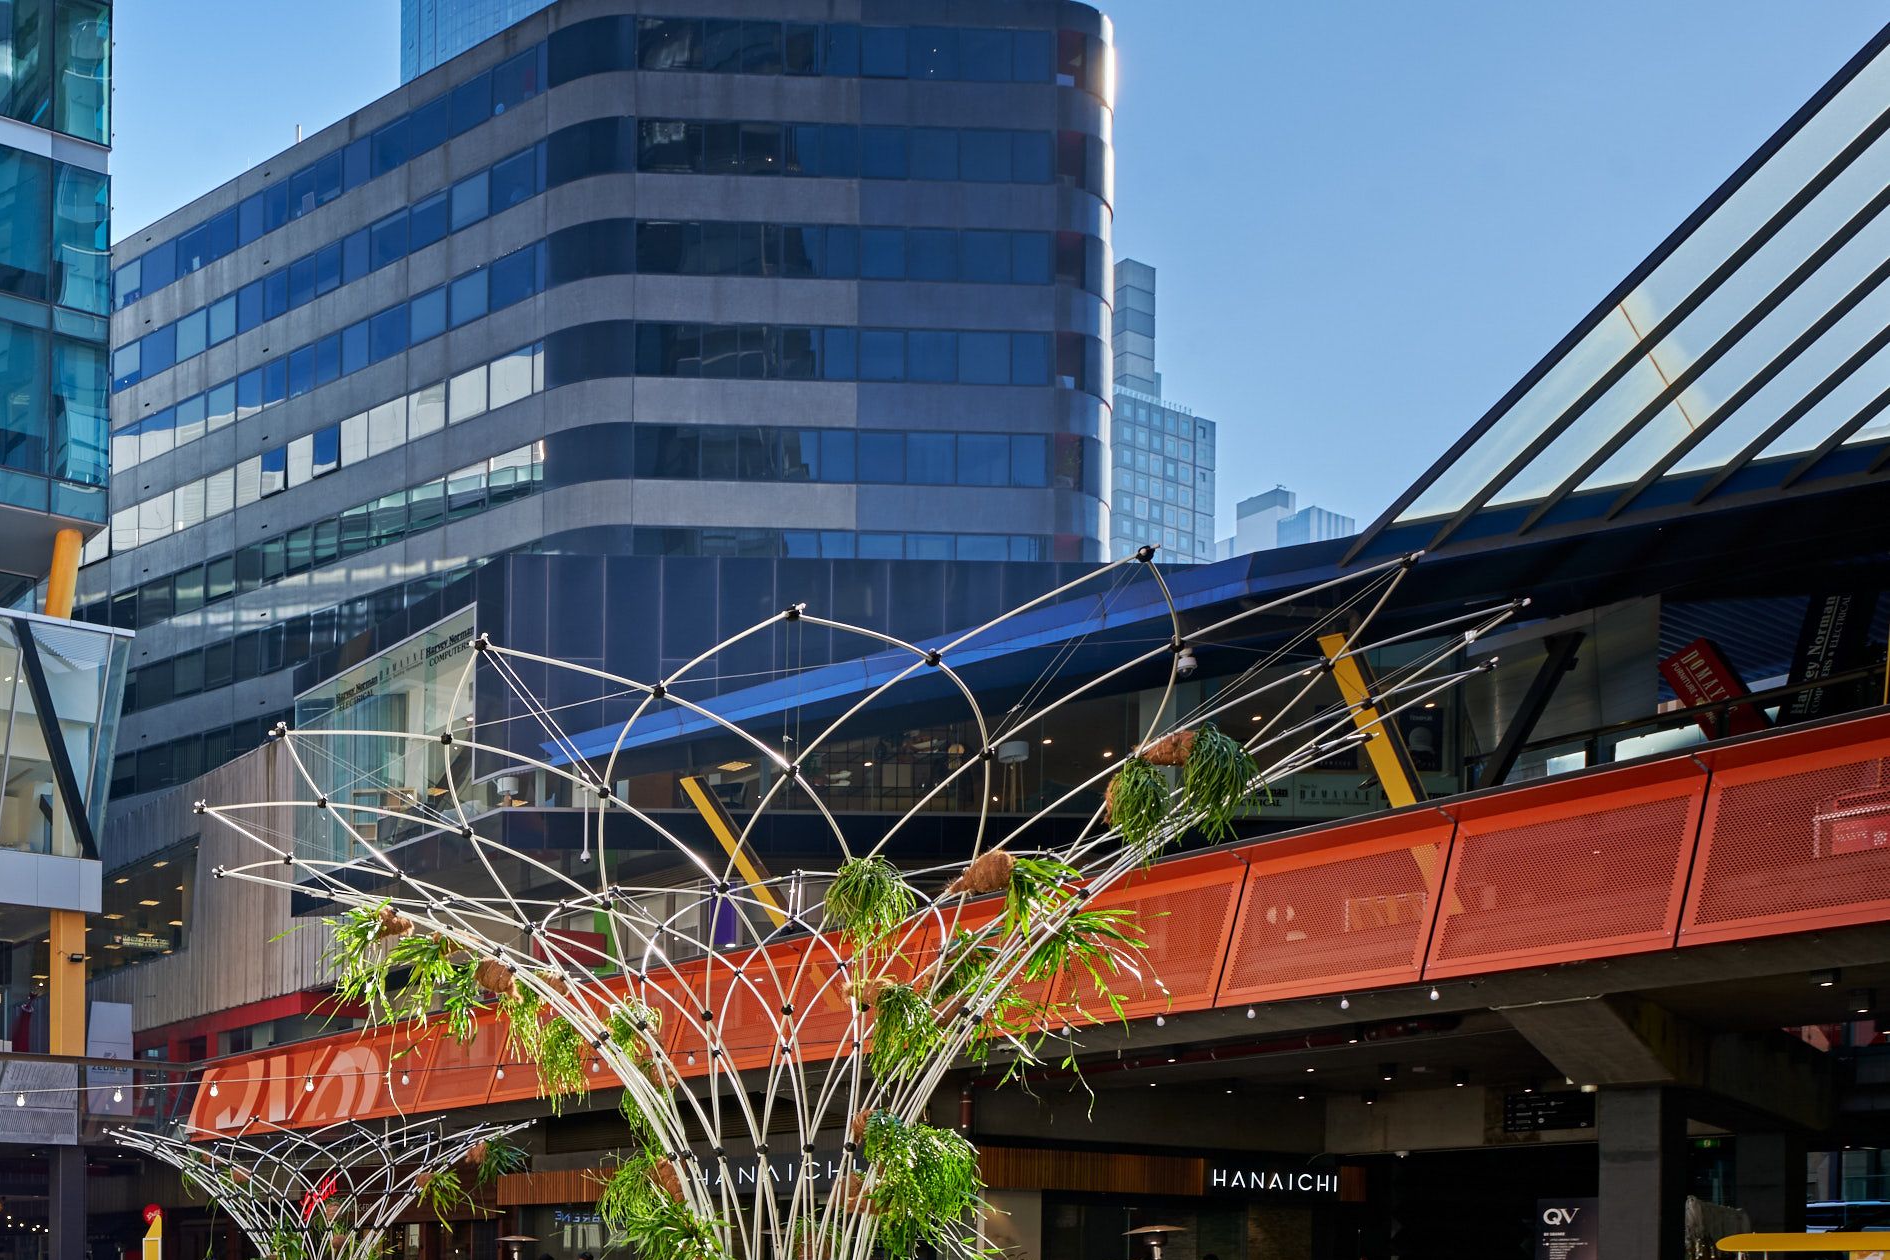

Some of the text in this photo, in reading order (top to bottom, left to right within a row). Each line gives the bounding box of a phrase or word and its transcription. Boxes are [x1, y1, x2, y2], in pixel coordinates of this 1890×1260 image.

[1790, 595, 1838, 714] Harey Norman
[1671, 662, 1698, 695] FURNITURE
[1213, 1168, 1338, 1193] HANAICHI
[1543, 1207, 1581, 1226] QV
